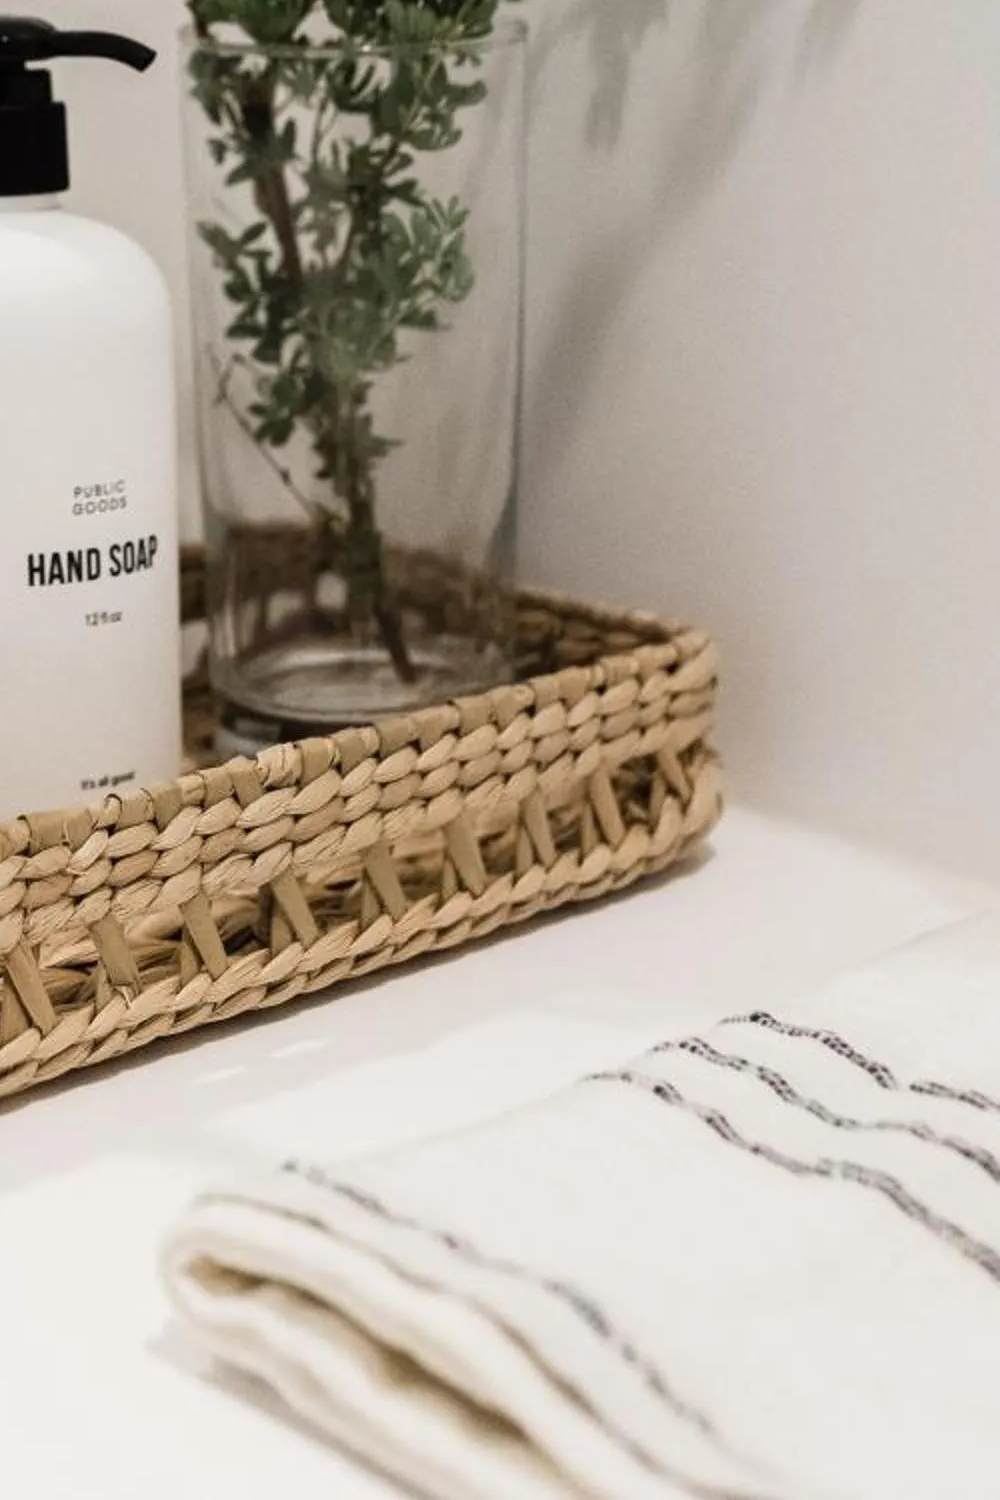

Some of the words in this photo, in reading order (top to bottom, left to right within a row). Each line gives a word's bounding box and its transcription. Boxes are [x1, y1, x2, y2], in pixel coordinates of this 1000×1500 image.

[73, 479, 126, 498] PUBLIC
[71, 496, 128, 516] GOODS
[27, 547, 101, 587] HAND
[108, 534, 158, 577] SOAP
